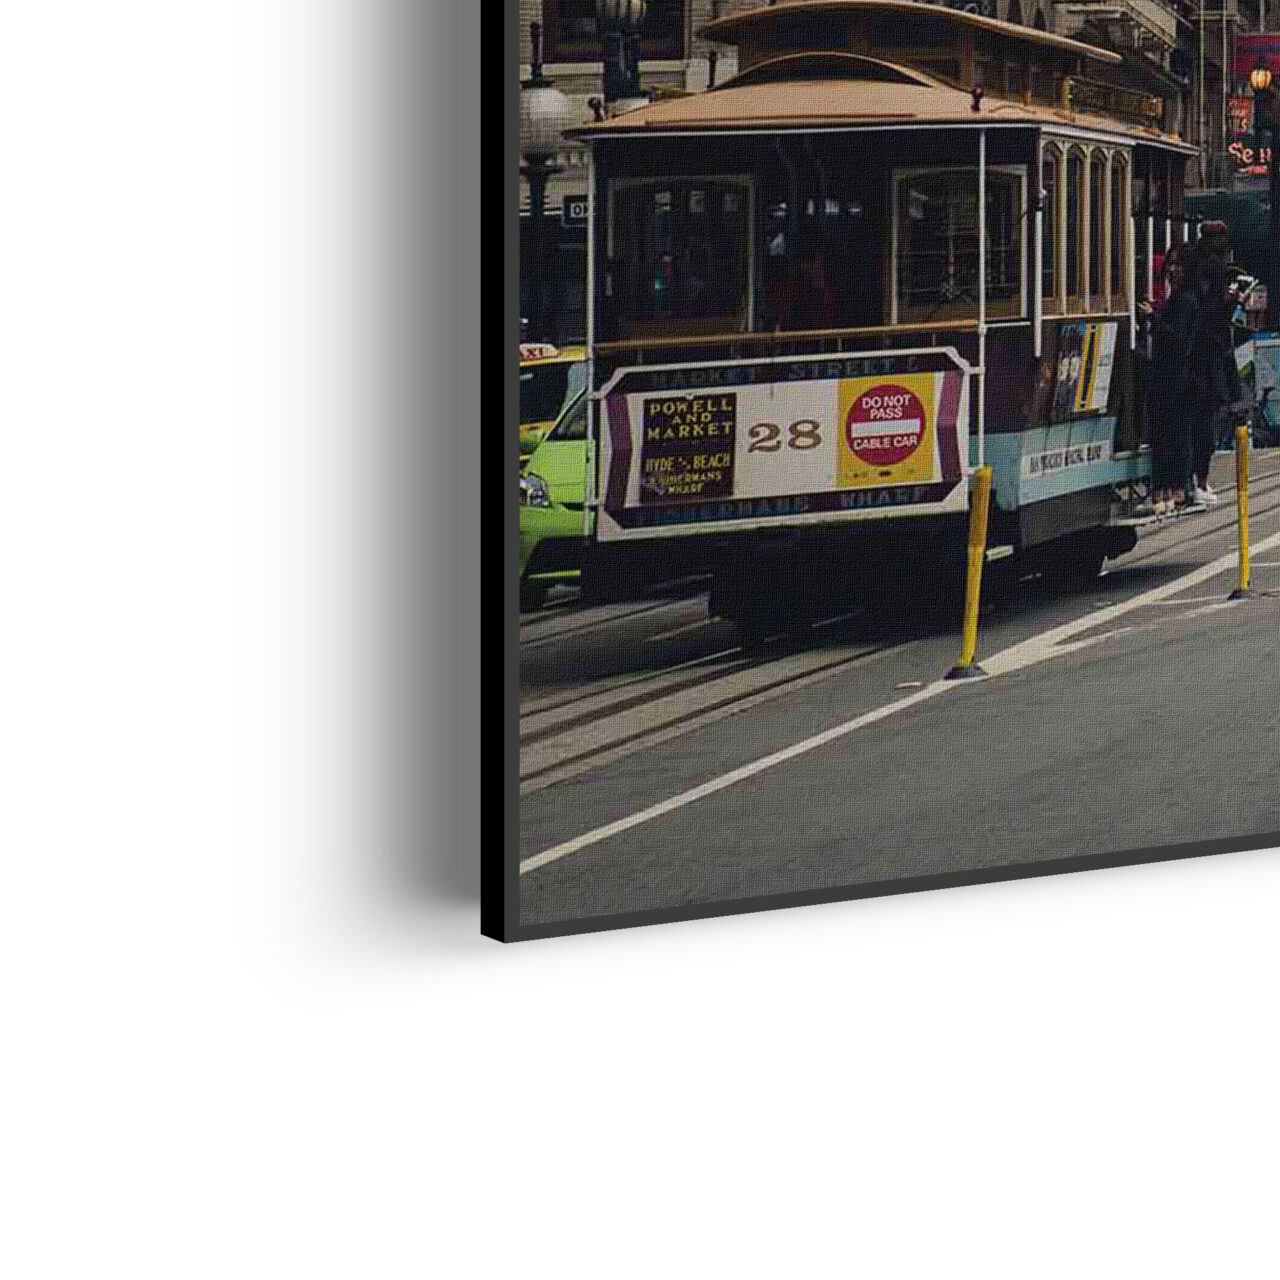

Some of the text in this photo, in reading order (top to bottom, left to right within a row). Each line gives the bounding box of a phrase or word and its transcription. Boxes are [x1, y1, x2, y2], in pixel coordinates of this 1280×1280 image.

[650, 399, 732, 417] POWELL
[862, 394, 911, 410] DO NOT
[671, 412, 712, 425] AND
[869, 407, 902, 419] PASS
[646, 421, 733, 441] MARKET
[747, 419, 823, 453] 28
[853, 435, 919, 451] CABLE CAR
[645, 456, 676, 473] HYDE
[693, 452, 731, 470] BEACH
